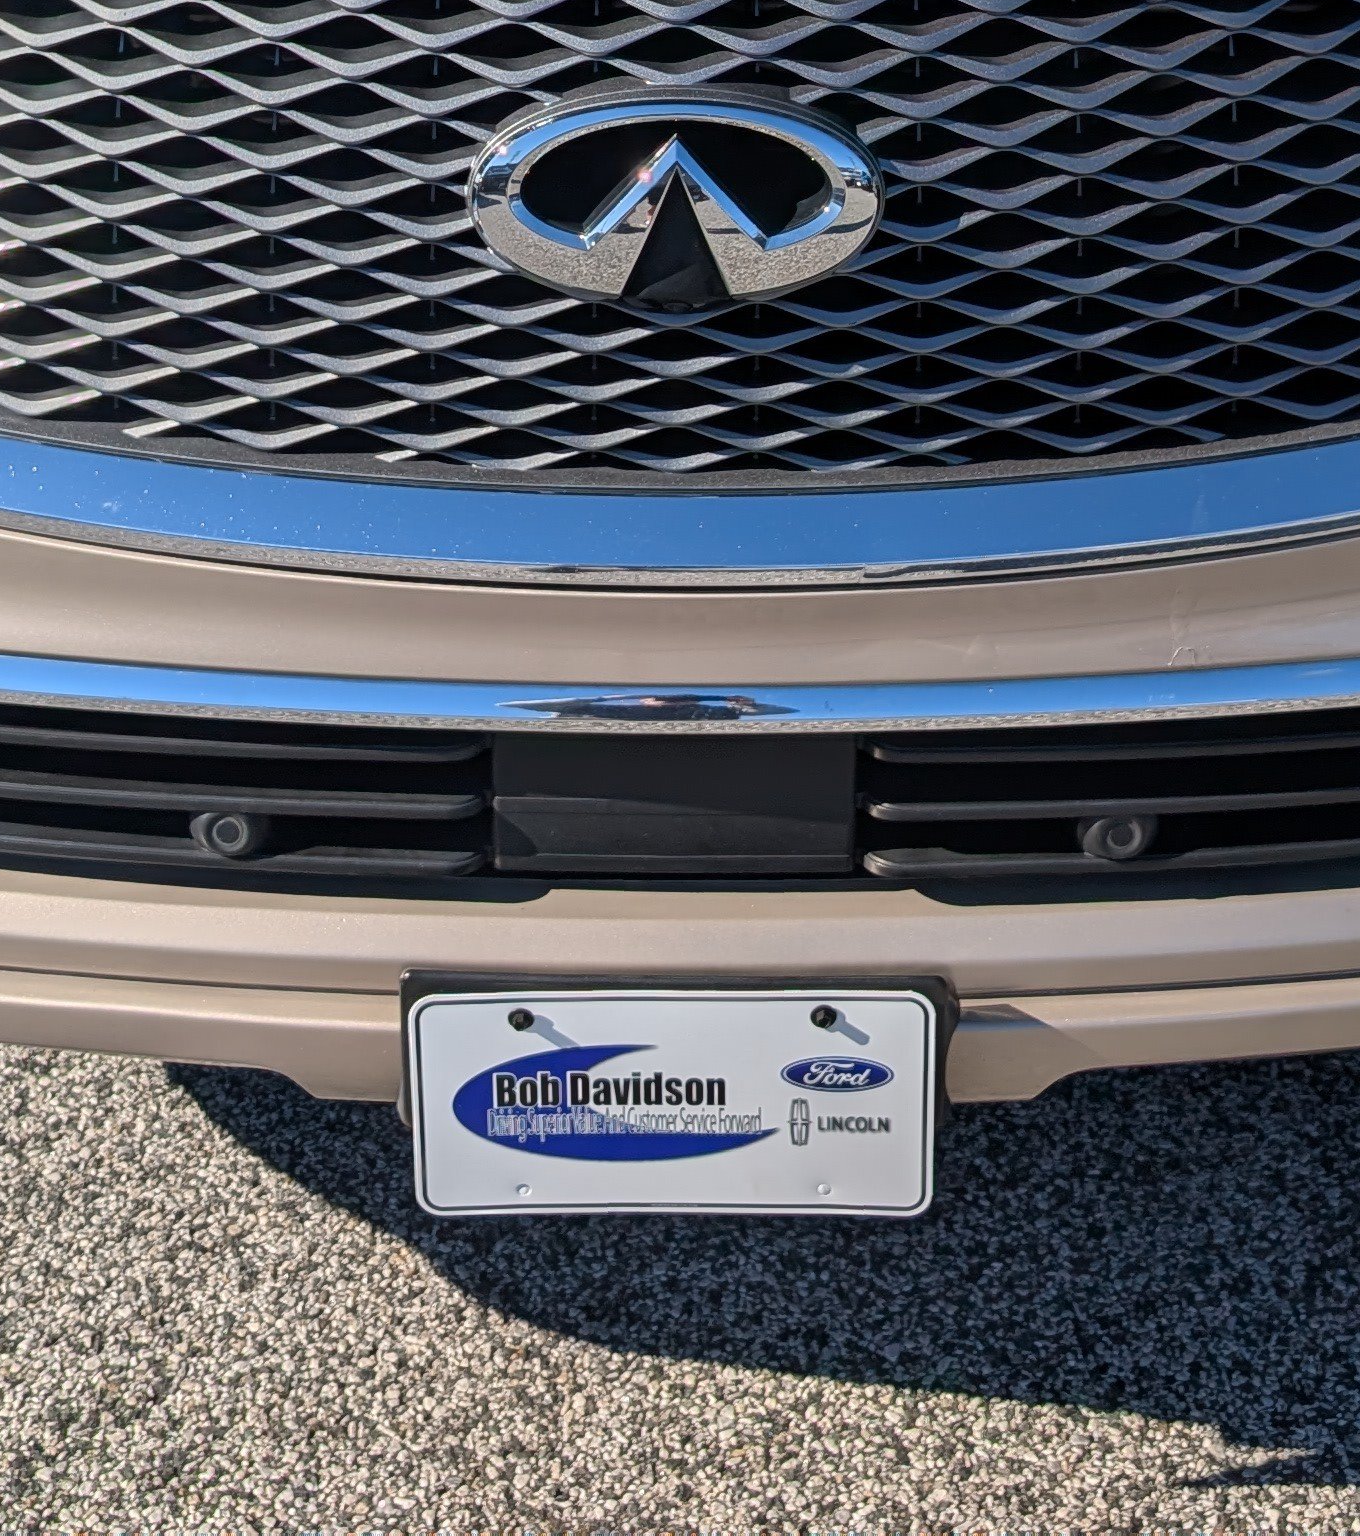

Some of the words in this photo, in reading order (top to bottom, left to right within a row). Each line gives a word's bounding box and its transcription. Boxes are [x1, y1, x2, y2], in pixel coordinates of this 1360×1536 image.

[803, 1061, 872, 1086] Ford
[493, 1071, 562, 1107] Bob
[567, 1071, 727, 1106] Davidson
[627, 1106, 678, 1134] Customer
[679, 1106, 717, 1134] Service
[718, 1106, 762, 1134] Forward
[817, 1115, 892, 1134] LINCOLN
